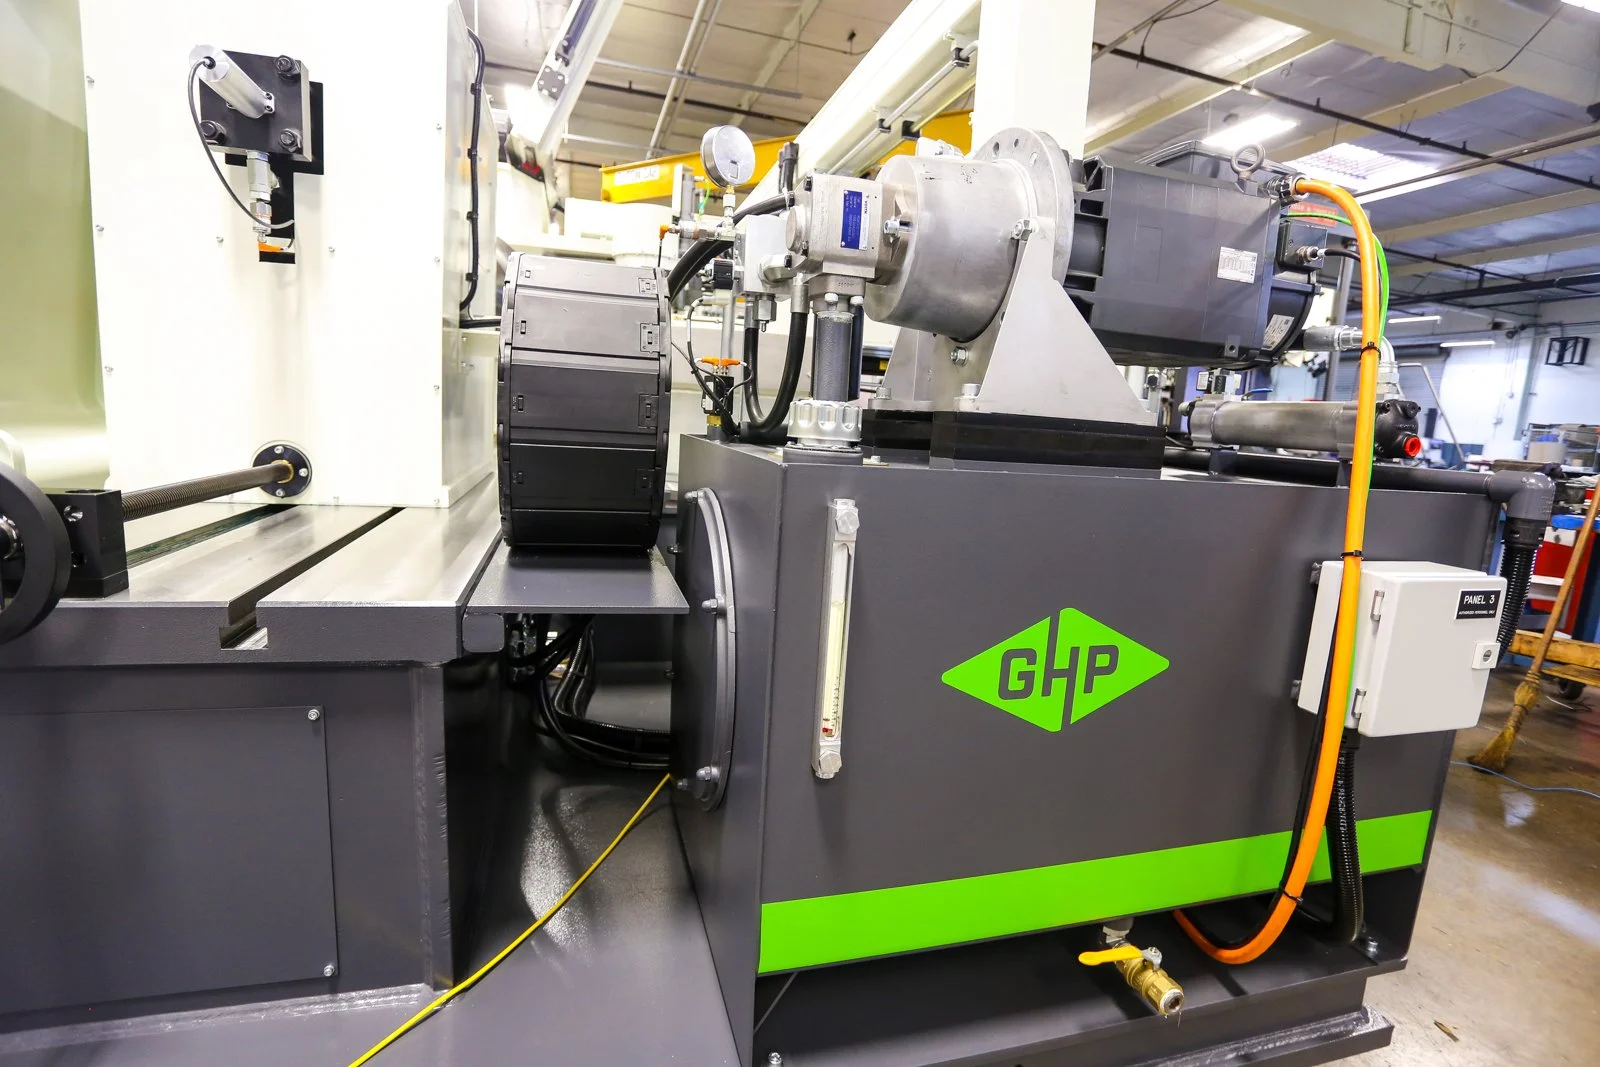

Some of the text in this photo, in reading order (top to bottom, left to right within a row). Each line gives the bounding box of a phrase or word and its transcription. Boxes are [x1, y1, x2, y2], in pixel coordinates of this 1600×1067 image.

[1464, 594, 1495, 604] PANEL 3
[997, 615, 1120, 732] GHP
